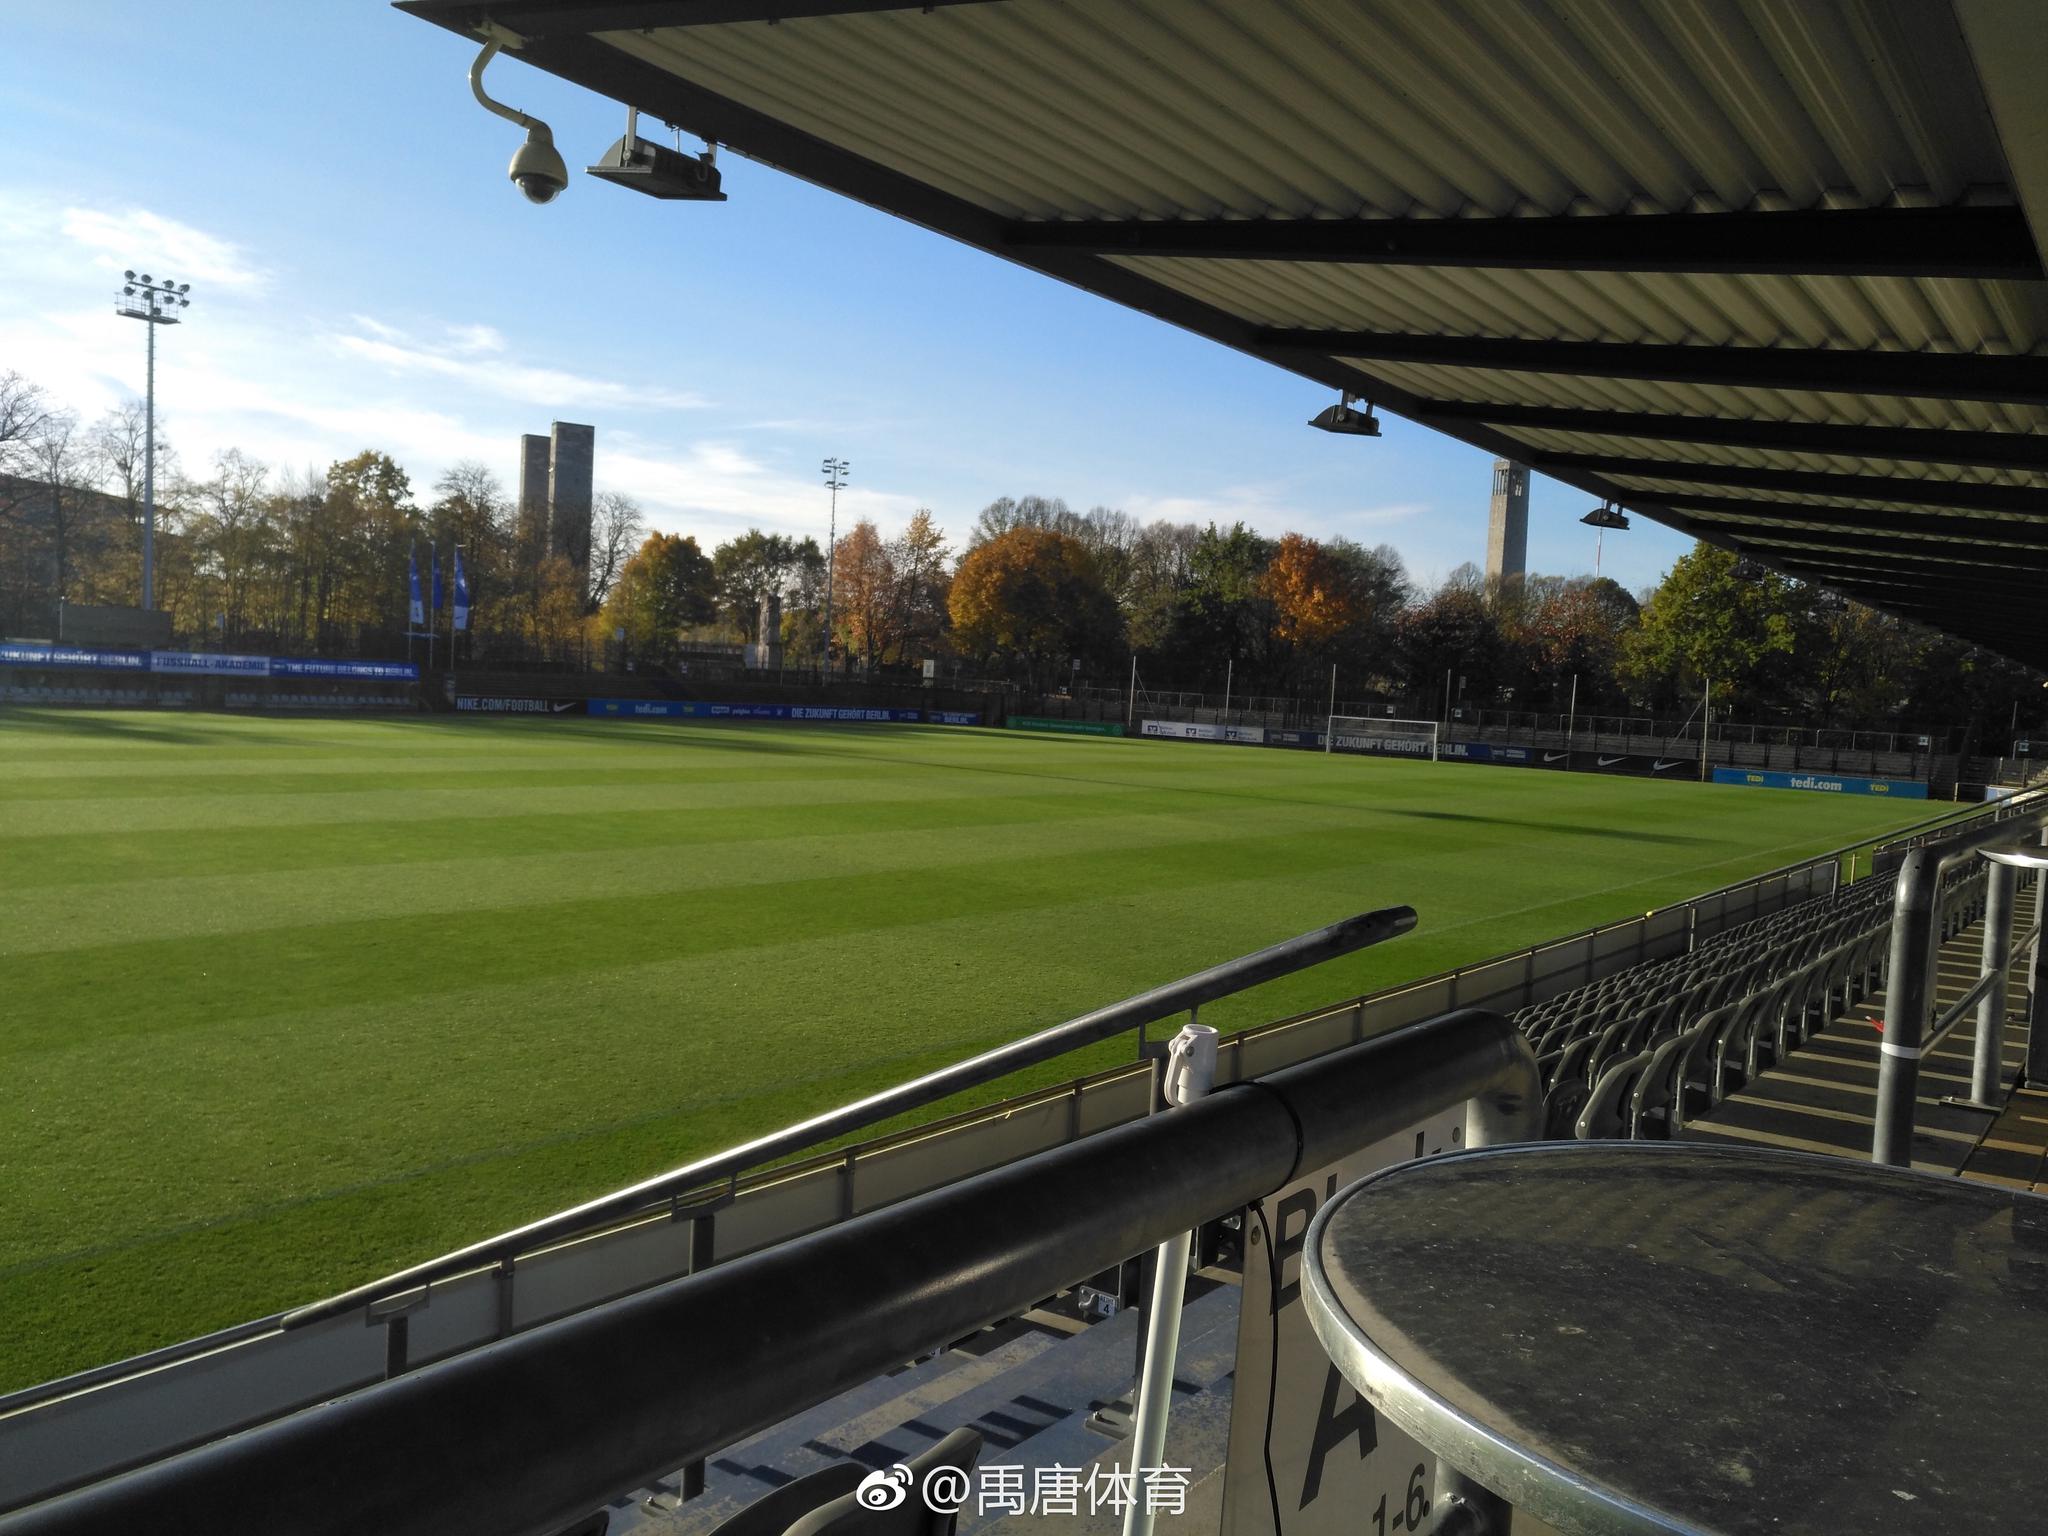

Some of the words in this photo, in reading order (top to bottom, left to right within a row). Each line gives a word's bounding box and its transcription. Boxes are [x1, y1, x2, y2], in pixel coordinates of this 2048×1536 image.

[287, 663, 303, 673] THE
[304, 664, 336, 674] FUTURE
[457, 697, 550, 712] NIKE.COM/FOOTBALL
[792, 707, 804, 719] DIE
[805, 708, 837, 719] ZUKUNFT
[1336, 736, 1383, 750] ZUKUNFT
[1790, 777, 1842, 791] tedi.com
[1298, 1362, 1378, 1511] A
